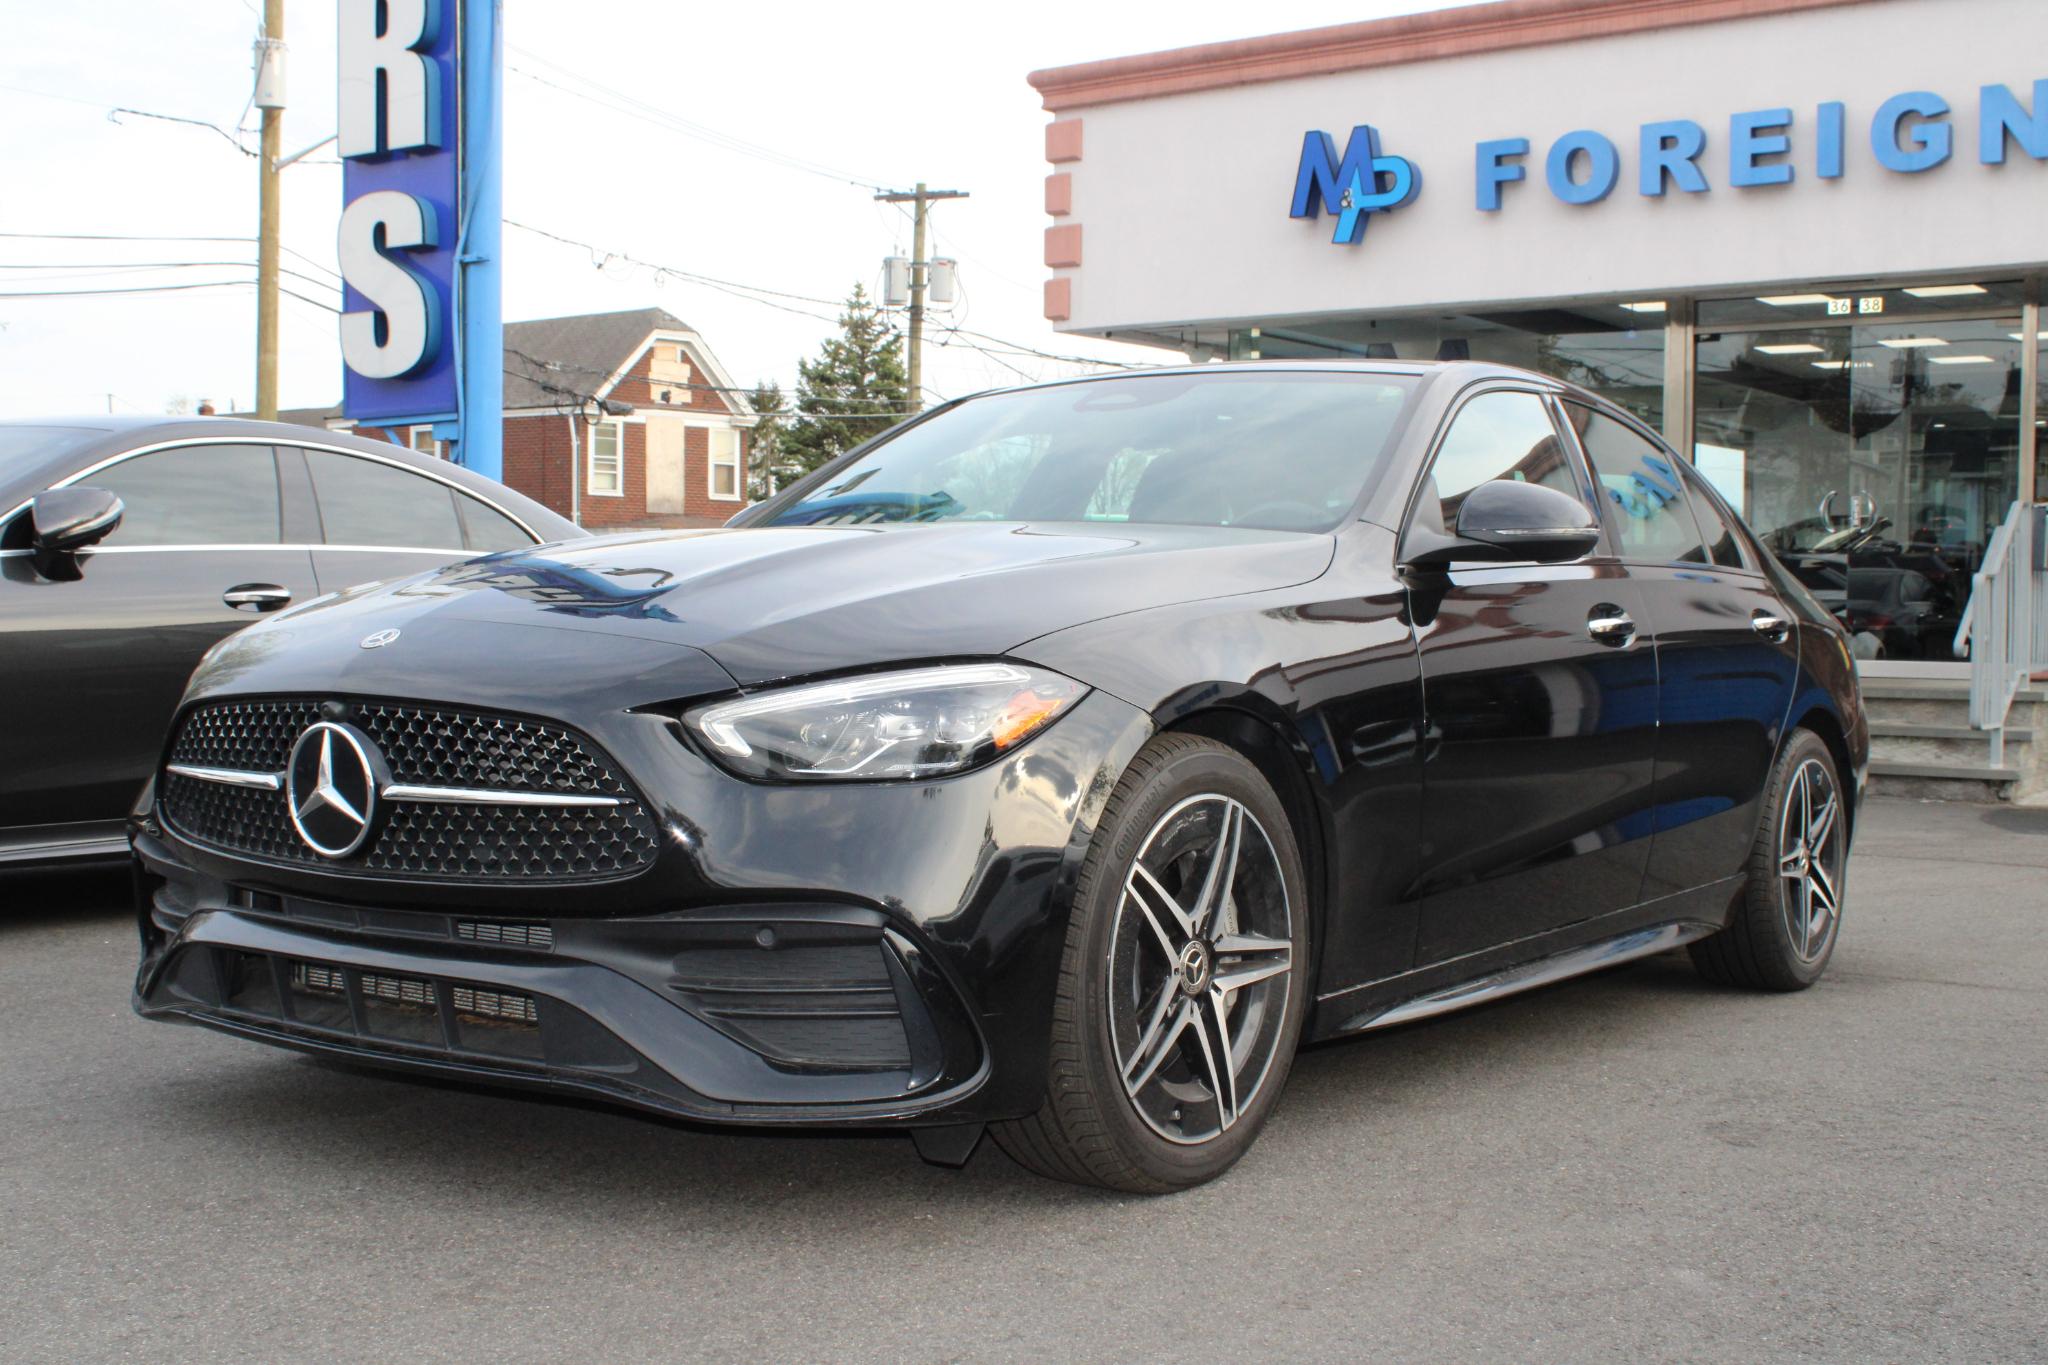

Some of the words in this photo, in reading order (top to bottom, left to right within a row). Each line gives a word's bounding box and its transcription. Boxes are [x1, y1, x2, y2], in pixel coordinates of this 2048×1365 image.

[1475, 78, 2048, 212] FOREIGN
[1830, 300, 1849, 312] 36
[1862, 299, 1881, 311] 38
